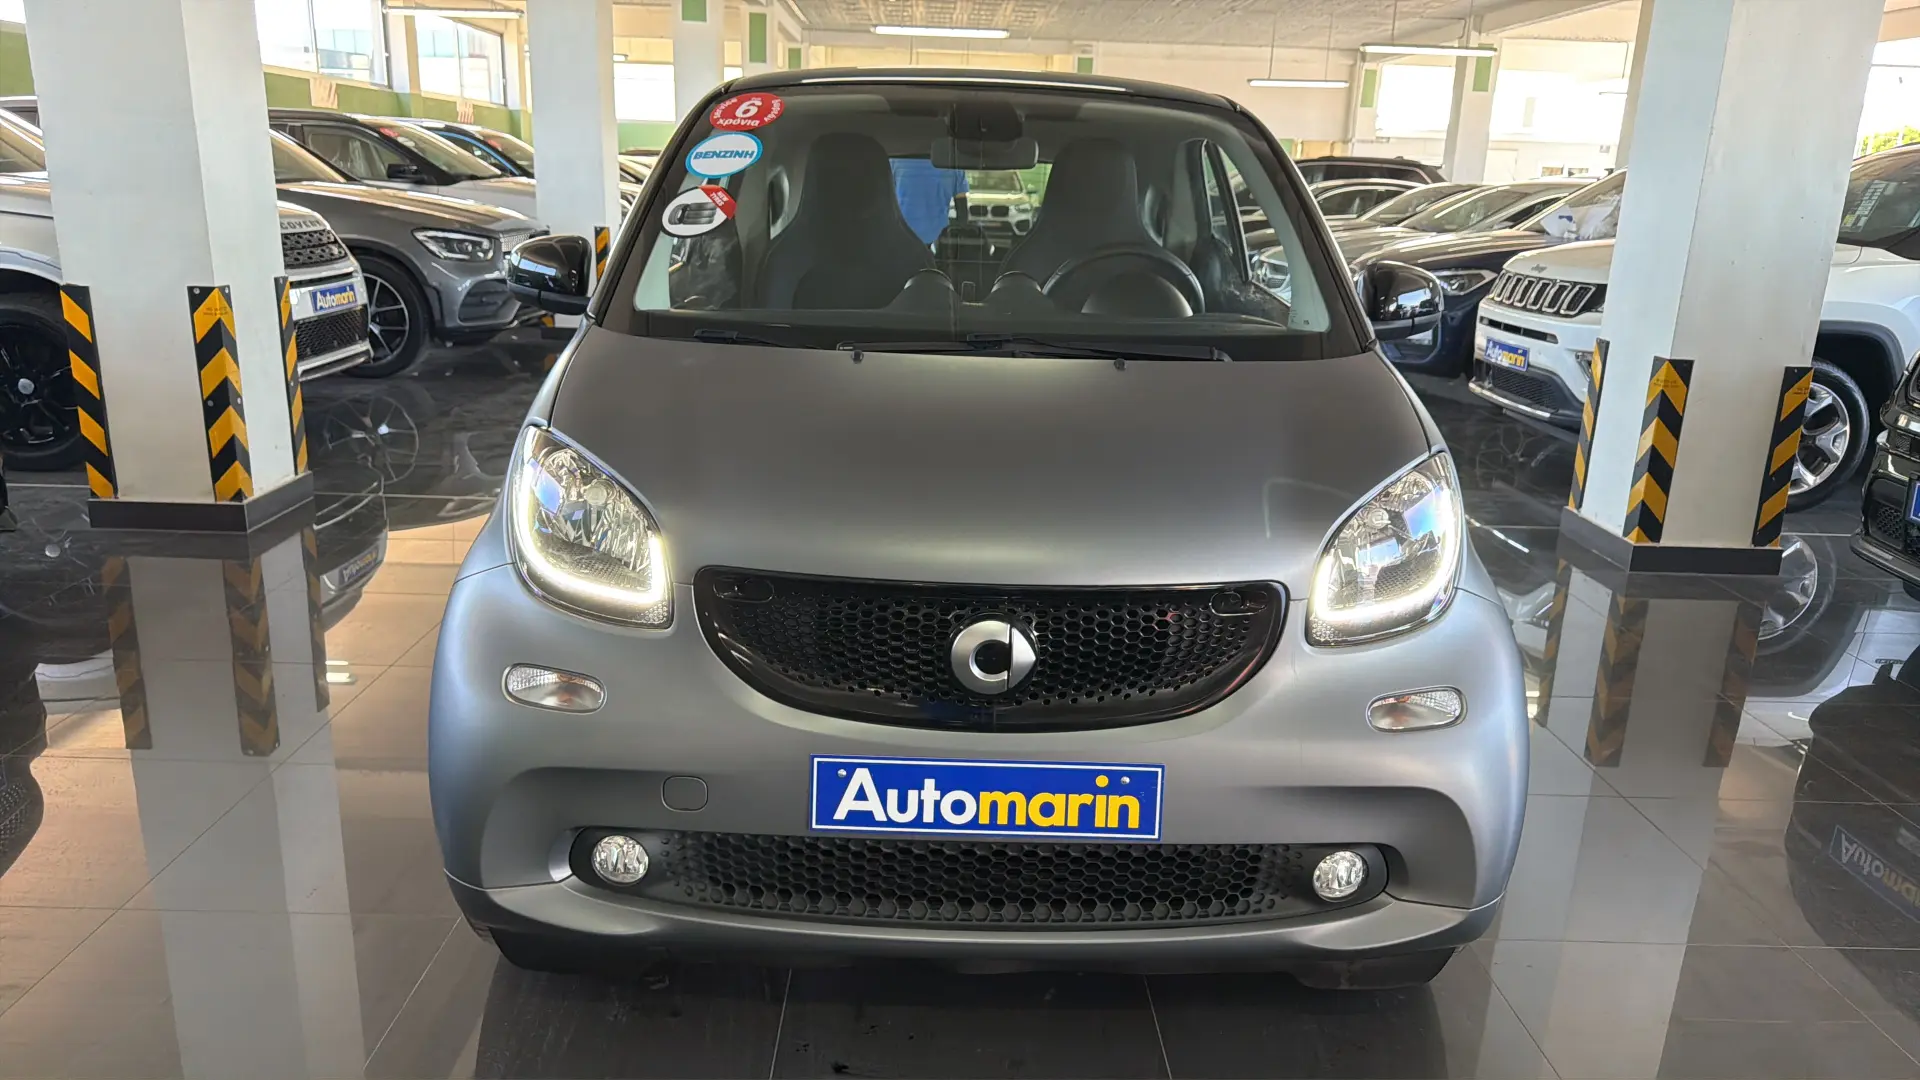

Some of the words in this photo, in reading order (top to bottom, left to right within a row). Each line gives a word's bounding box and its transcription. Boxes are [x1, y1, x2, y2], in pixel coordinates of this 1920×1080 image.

[735, 99, 763, 118] 6
[717, 117, 760, 127] χρόνια
[316, 285, 356, 310] Automarin
[1486, 341, 1525, 367] Automarin
[833, 768, 1140, 829] Automarin
